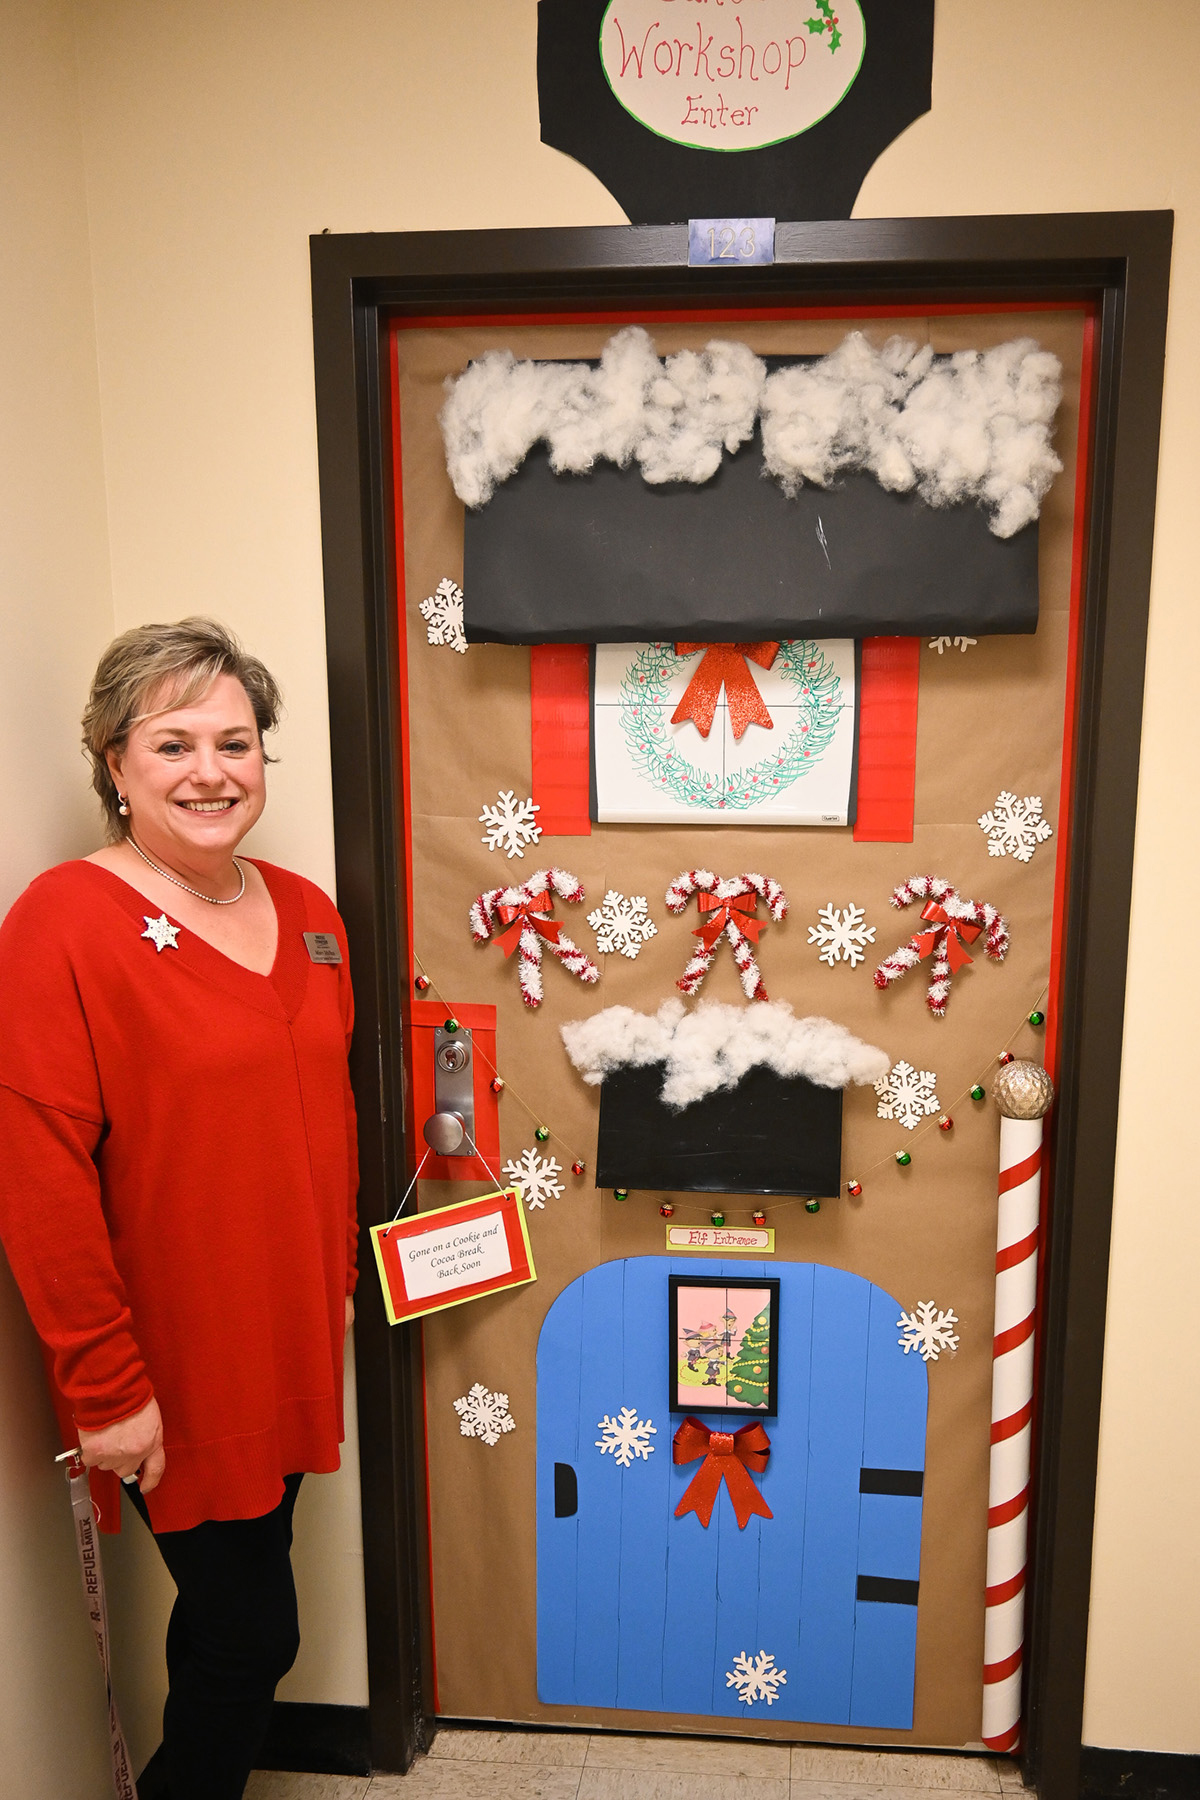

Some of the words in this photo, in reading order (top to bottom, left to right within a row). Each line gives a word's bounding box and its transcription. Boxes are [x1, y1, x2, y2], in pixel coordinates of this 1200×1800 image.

[612, 15, 807, 90] Workshop
[681, 93, 759, 129] Enter
[707, 226, 756, 258] 123
[408, 1248, 431, 1262] Gone
[432, 1244, 443, 1253] on
[445, 1241, 451, 1249] a
[452, 1231, 481, 1247] Cookie
[482, 1223, 499, 1238] and
[688, 1230, 708, 1246] Elf
[713, 1231, 758, 1246] Entrance
[430, 1254, 455, 1268] Cocoa
[457, 1243, 485, 1259] Break
[437, 1264, 461, 1279] Back
[460, 1260, 481, 1273] Soon
